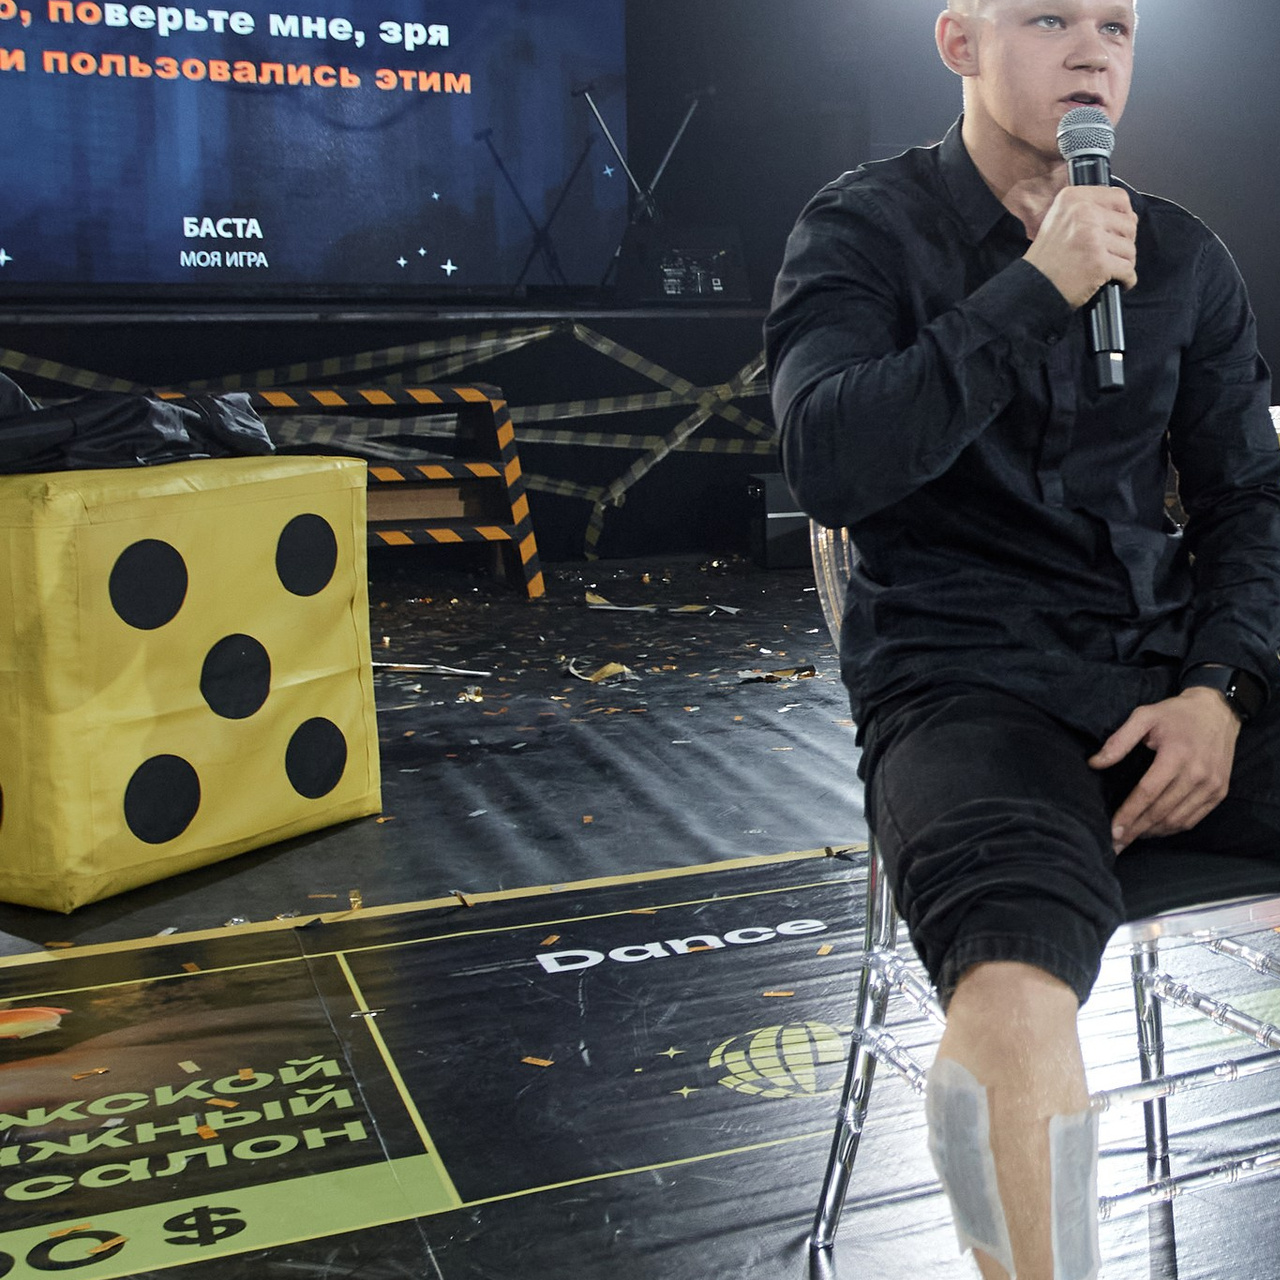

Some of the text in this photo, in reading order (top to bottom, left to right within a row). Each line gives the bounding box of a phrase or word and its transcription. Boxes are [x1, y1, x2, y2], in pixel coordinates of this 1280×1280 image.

[48, 0, 255, 37] поверьте
[269, 13, 366, 48] мне,
[379, 20, 449, 51] зря
[42, 50, 361, 89] пользовались
[375, 68, 471, 94] этим
[183, 217, 264, 239] БАСТА
[180, 251, 269, 268] МОЯ ИГРА
[535, 919, 829, 974] Dance
[0, 1084, 354, 1167] жный
[4, 1120, 367, 1201] салон
